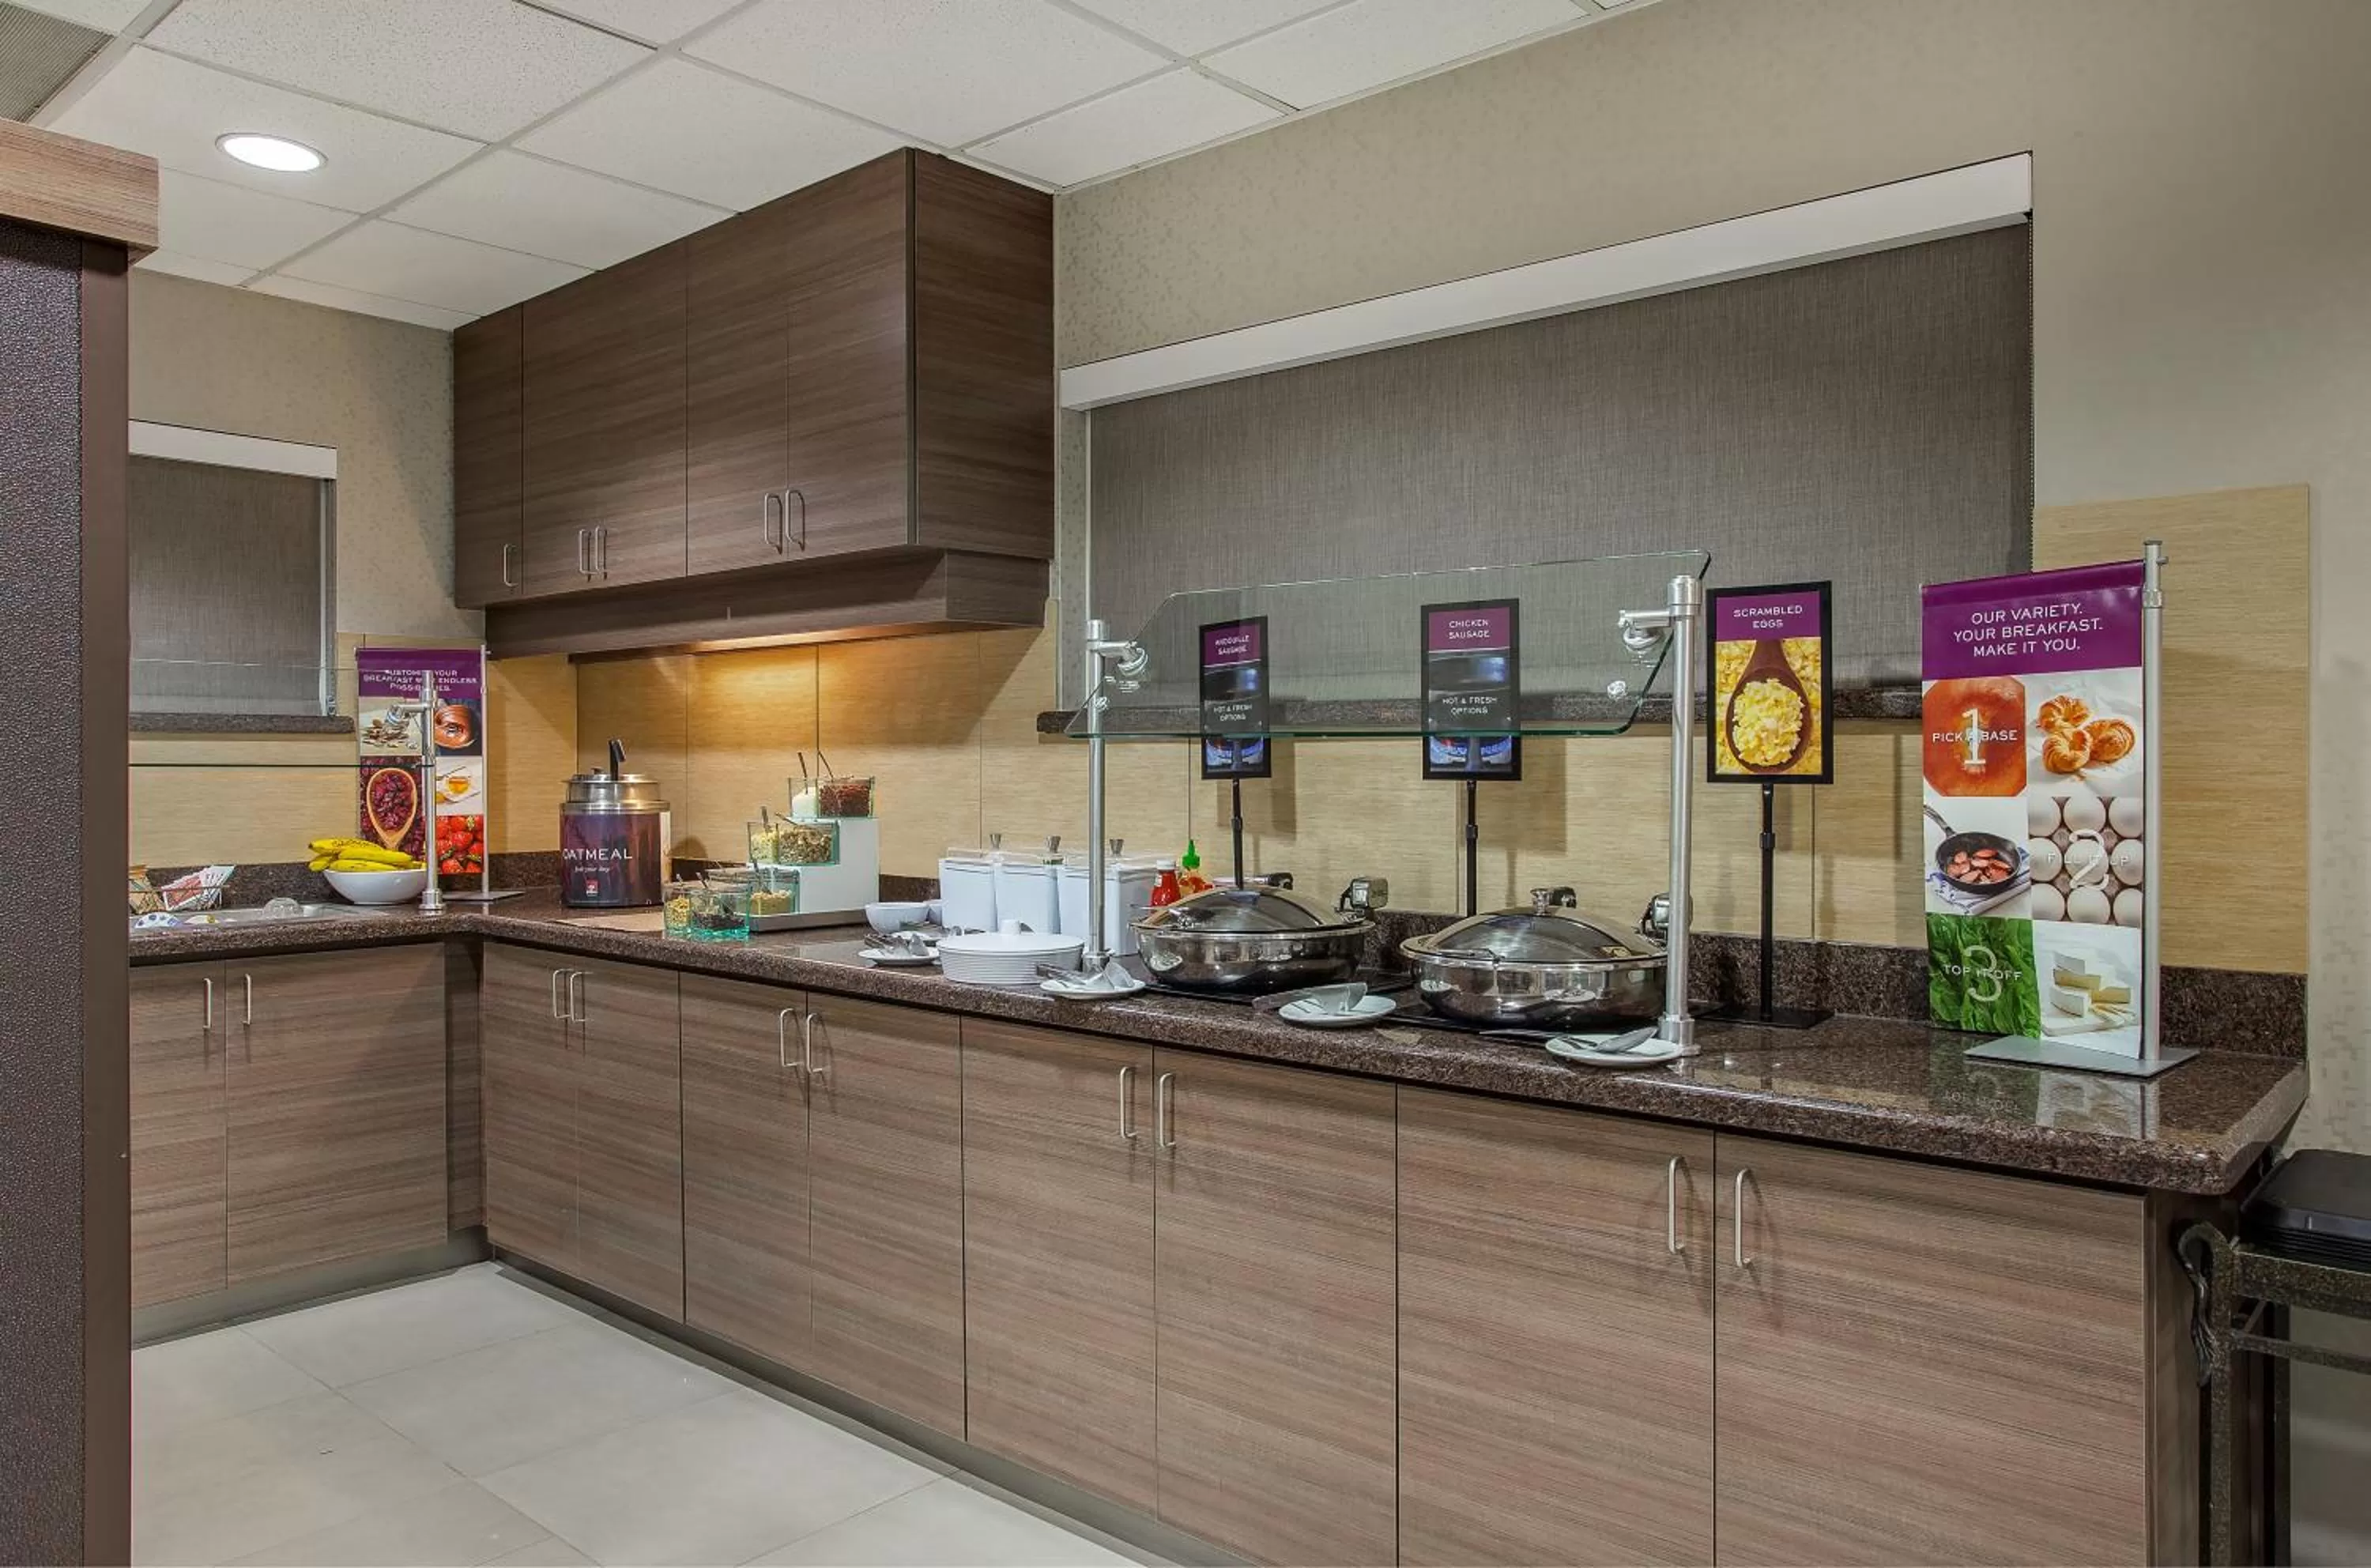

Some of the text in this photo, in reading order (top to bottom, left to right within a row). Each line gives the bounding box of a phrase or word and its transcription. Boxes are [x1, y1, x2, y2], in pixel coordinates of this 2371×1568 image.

[1732, 605, 1803, 618] SCRAMBLED
[1971, 602, 2083, 625] OUR VARIETY.
[1449, 619, 1489, 628] CHICKEN
[1752, 619, 1784, 629] EGGS
[1954, 617, 2104, 643] YOUR BREAKFAST.
[1449, 630, 1491, 639] SAUSAGE
[1973, 638, 2081, 658] MAKE IT YOU.
[1442, 696, 1458, 705] HOT
[1450, 707, 1488, 715] OPTIONS
[1932, 732, 1964, 743] PICK
[1981, 729, 2018, 741] BASE
[562, 847, 633, 861] OATMEAL
[1944, 964, 1971, 977] TOP
[1992, 969, 2023, 981] OFF
